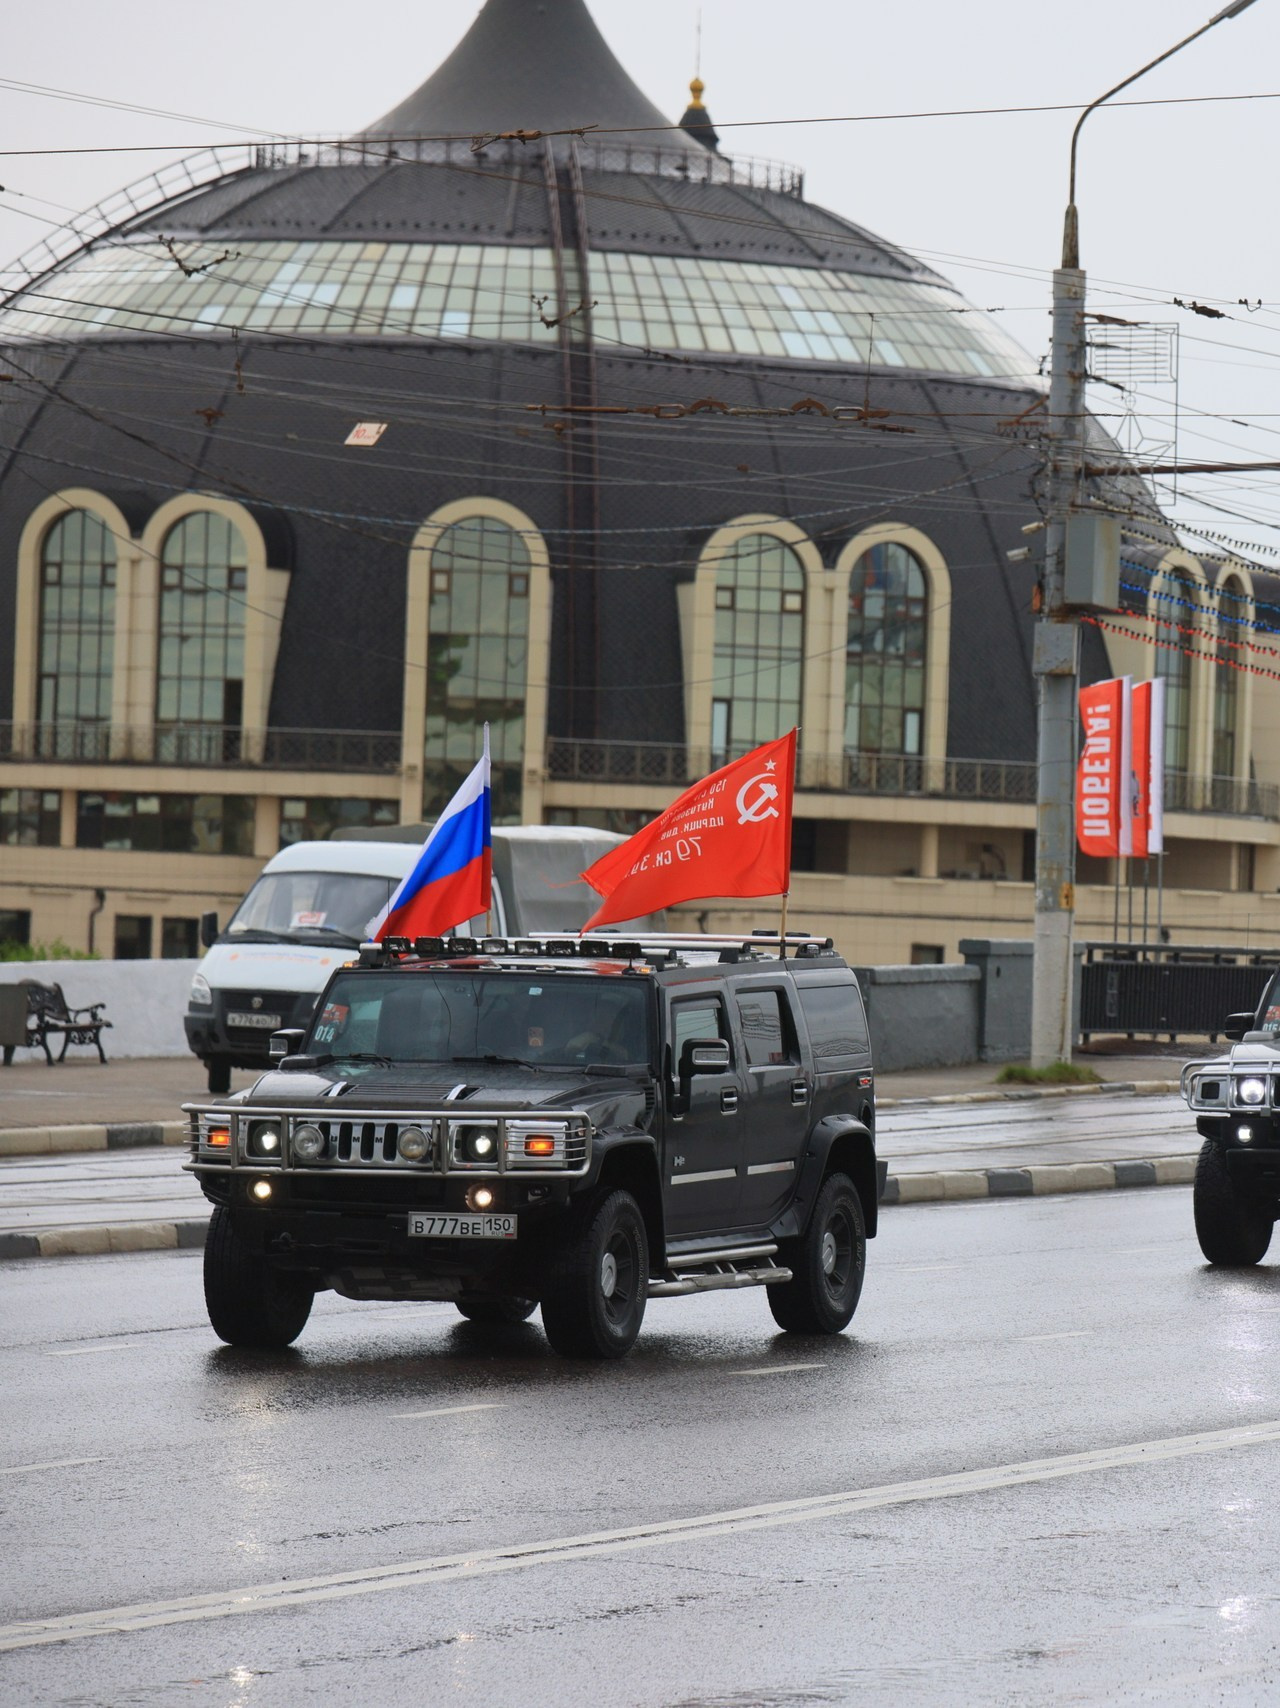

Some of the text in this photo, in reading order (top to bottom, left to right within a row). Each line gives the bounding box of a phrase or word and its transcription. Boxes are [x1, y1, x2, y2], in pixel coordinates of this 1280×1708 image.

[315, 1025, 335, 1043] 014
[414, 1217, 511, 1235] В777ВЕ 150
